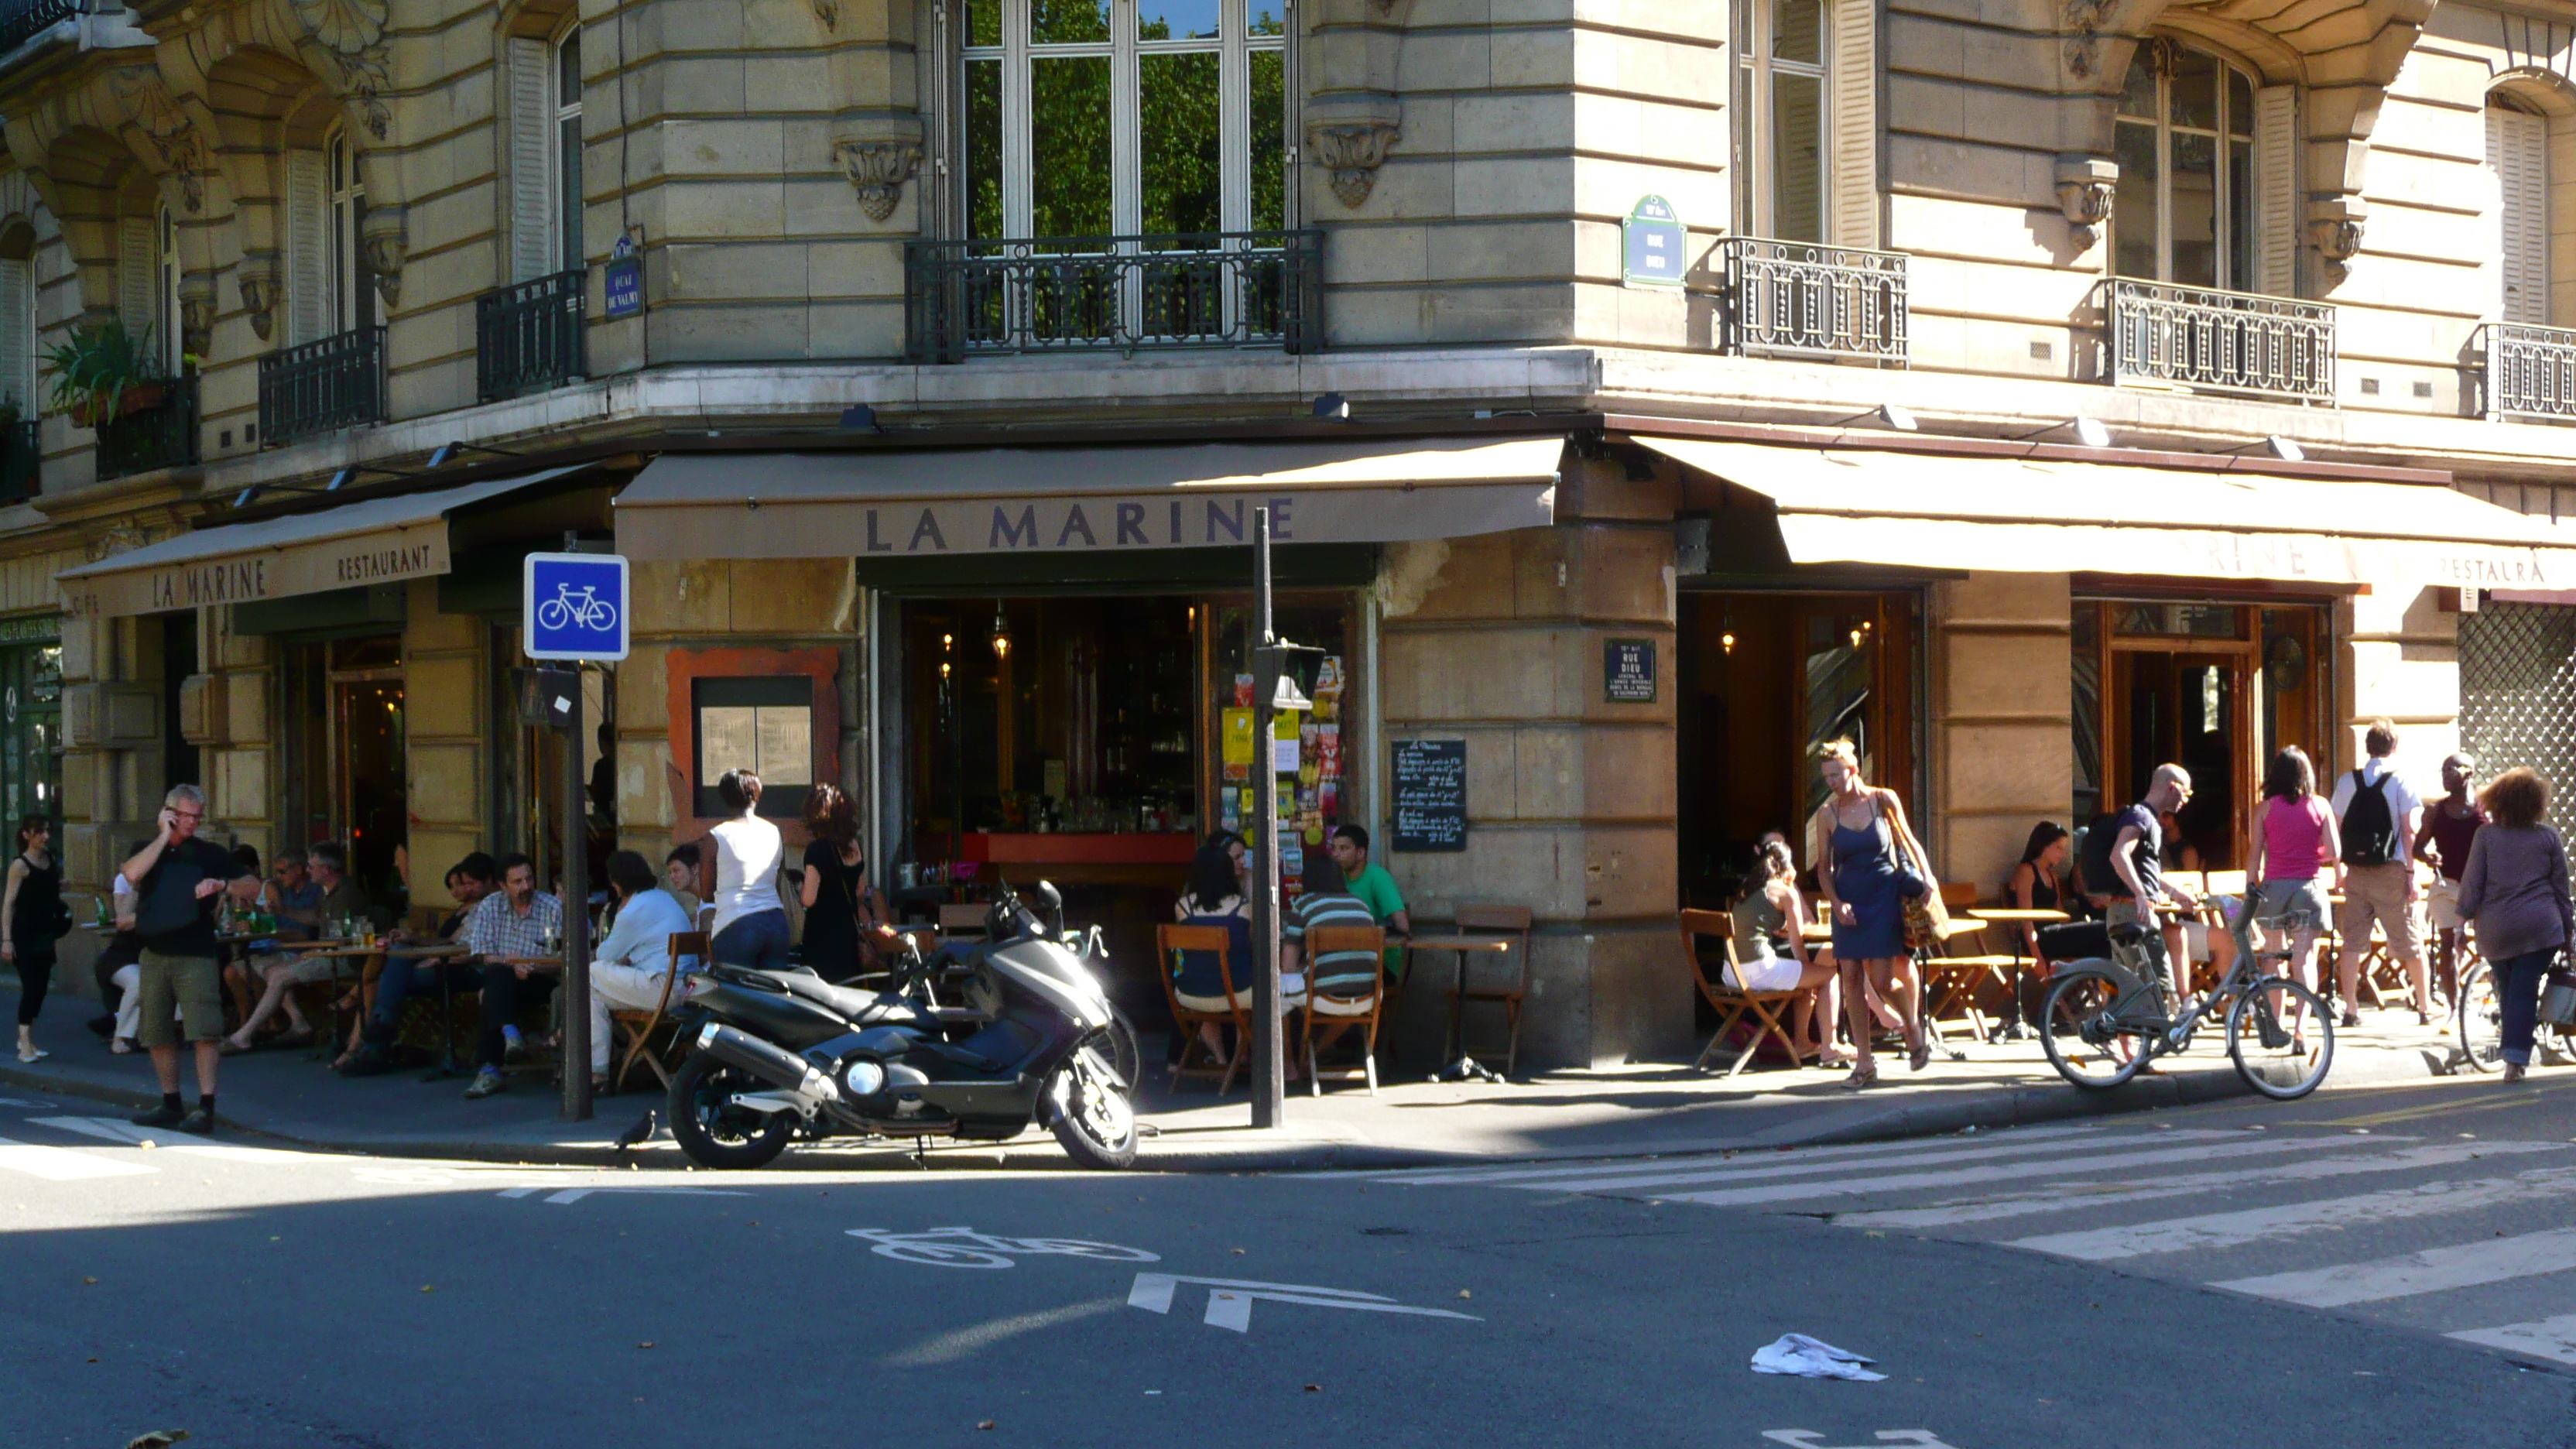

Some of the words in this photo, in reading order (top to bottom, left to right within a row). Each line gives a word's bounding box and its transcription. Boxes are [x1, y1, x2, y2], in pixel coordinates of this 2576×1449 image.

[1647, 234, 1663, 248] RUE
[1646, 255, 1665, 269] DIEU
[615, 274, 632, 291] QUAI
[866, 508, 947, 551] LA
[989, 498, 1293, 548] MARINE
[153, 574, 174, 608] LA
[187, 559, 265, 604] MARINE
[337, 545, 430, 581] RESTAURANT
[1623, 653, 1638, 663] RUE
[1622, 663, 1640, 673] DIEU
